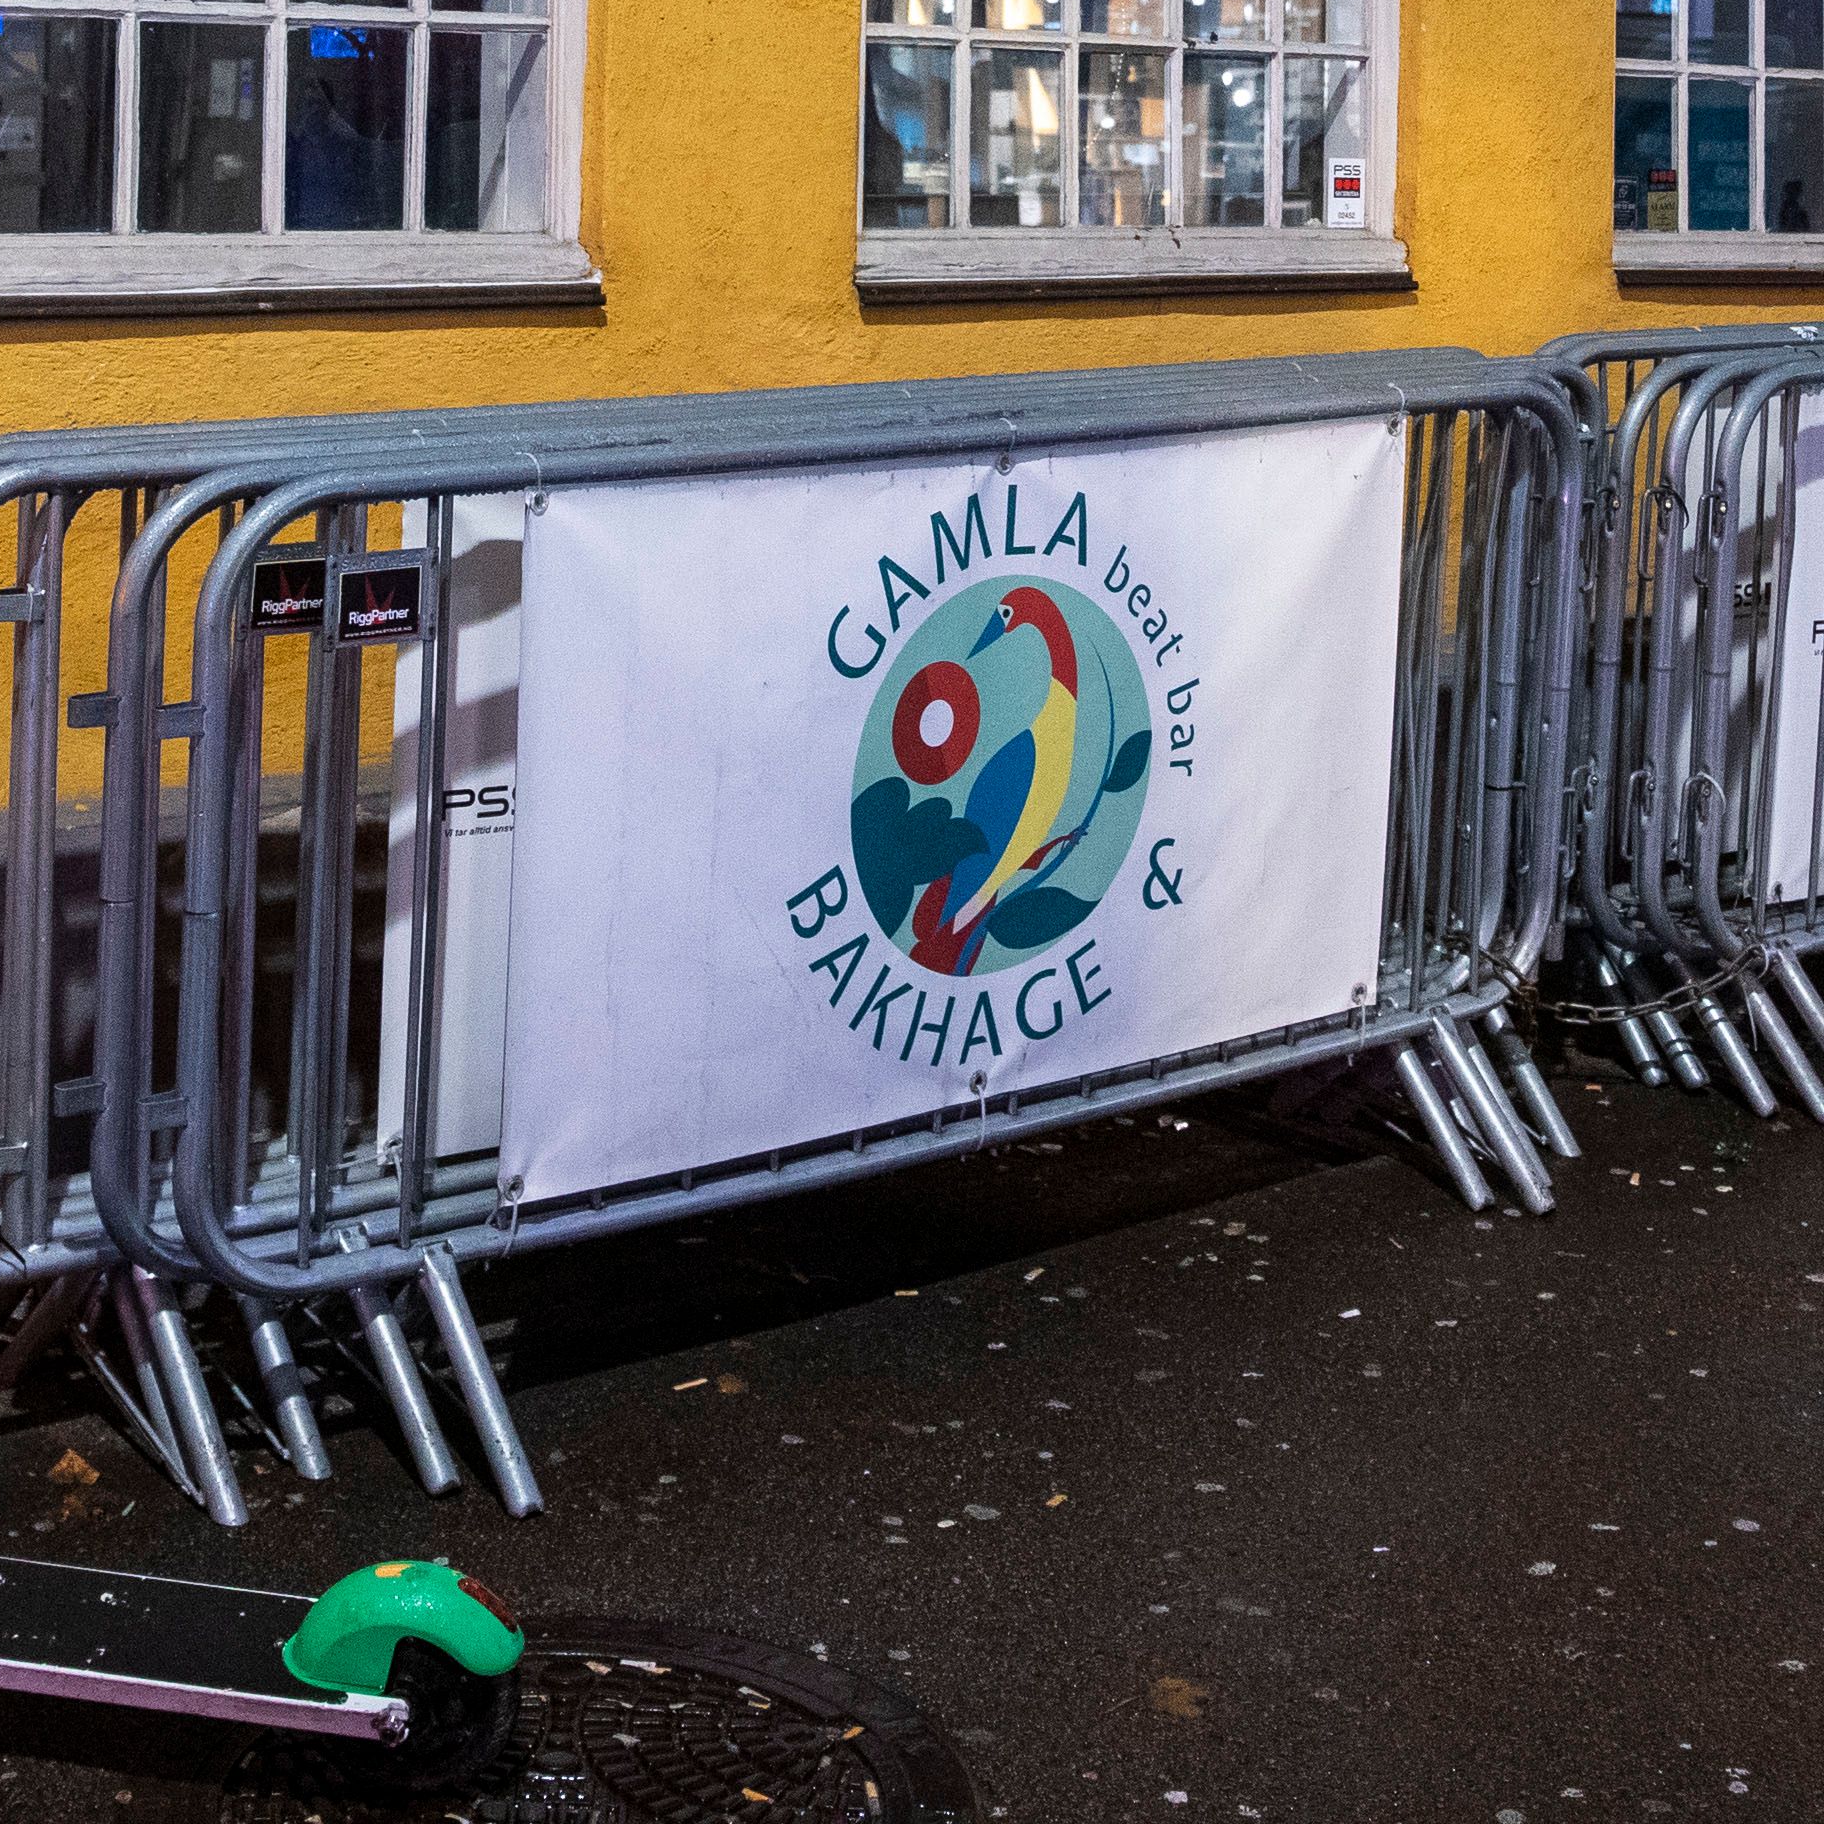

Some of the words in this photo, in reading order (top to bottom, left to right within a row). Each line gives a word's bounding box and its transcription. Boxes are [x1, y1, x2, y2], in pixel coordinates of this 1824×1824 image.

[1333, 164, 1362, 176] PSS
[261, 598, 323, 615] RiggPartner
[348, 607, 410, 626] RiggPartner
[826, 484, 1088, 682] GAMLA
[1104, 544, 1185, 667] beat
[1167, 678, 1198, 778] bar
[441, 785, 516, 822] PS
[1141, 837, 1184, 912] &
[787, 864, 1114, 1068] BAKHAGE
